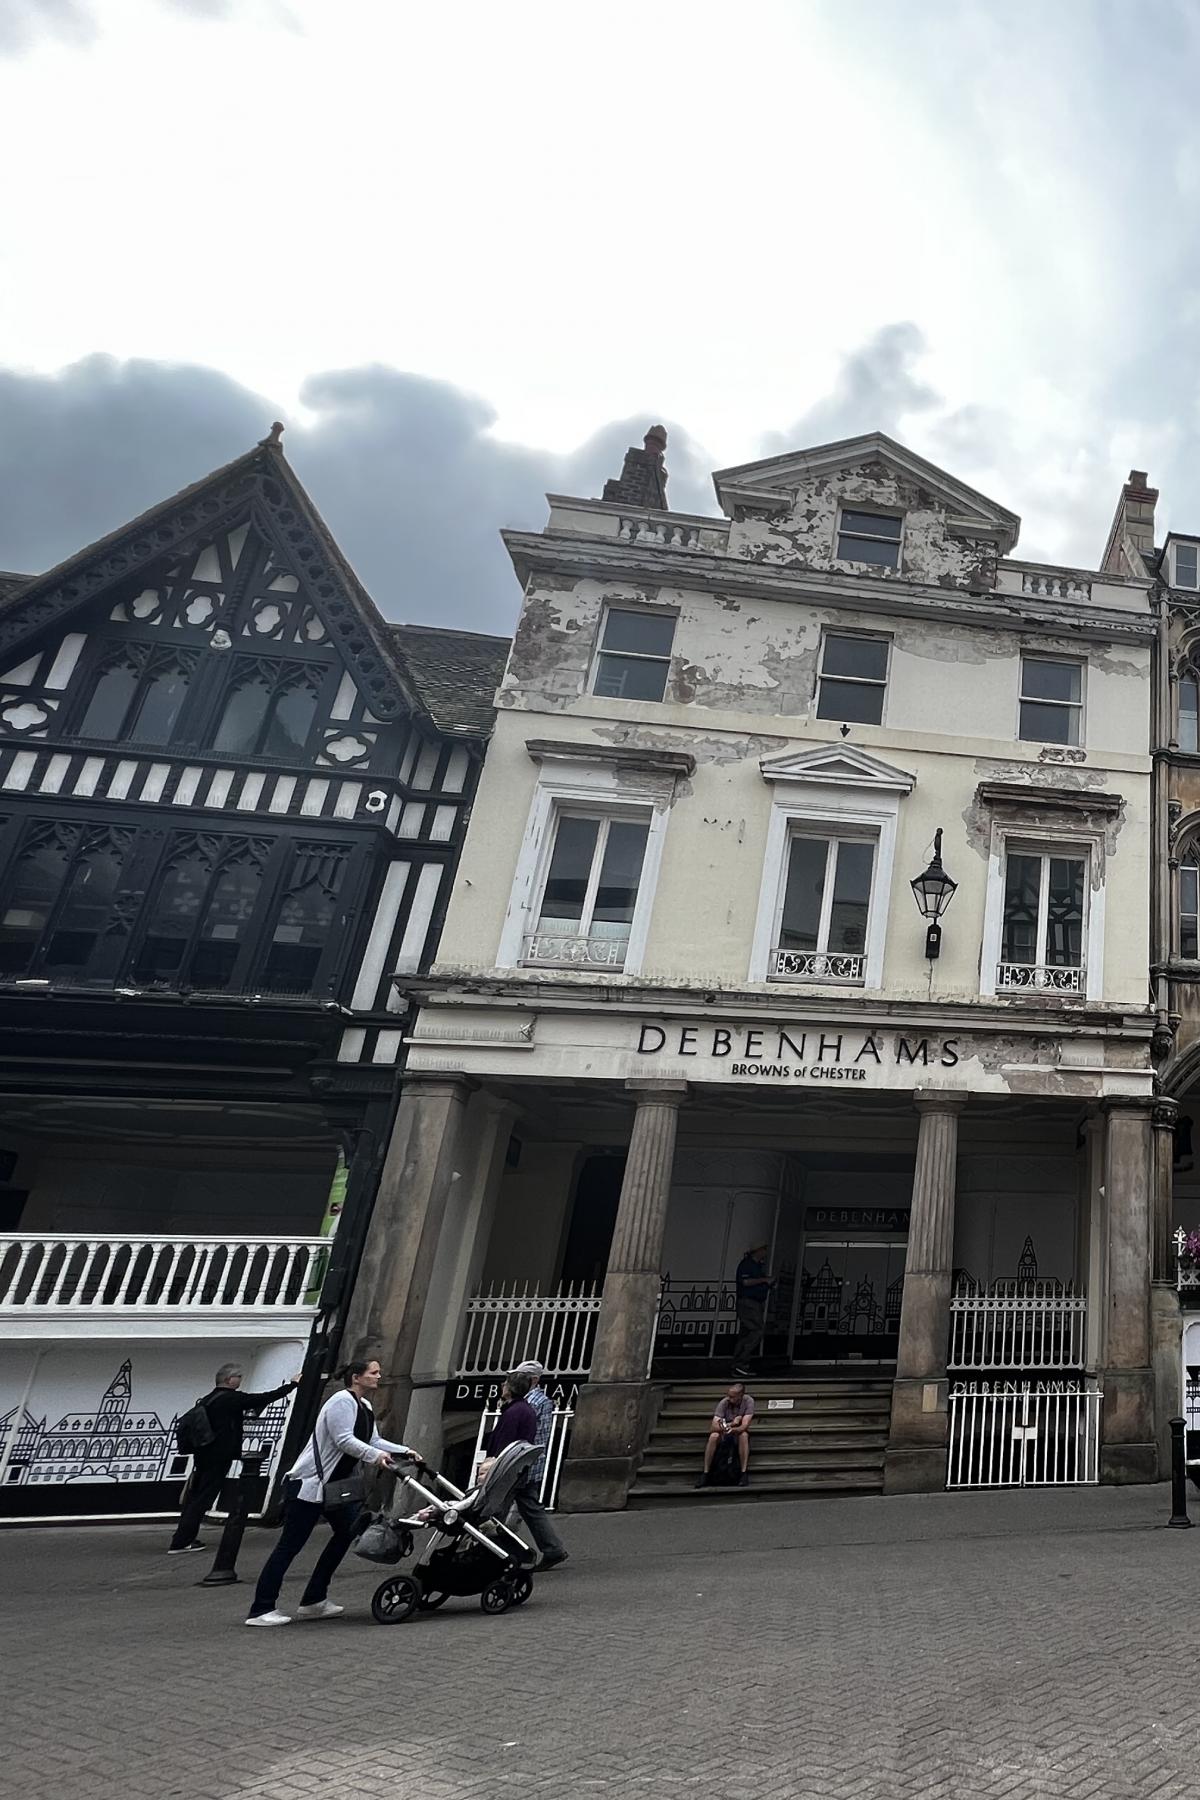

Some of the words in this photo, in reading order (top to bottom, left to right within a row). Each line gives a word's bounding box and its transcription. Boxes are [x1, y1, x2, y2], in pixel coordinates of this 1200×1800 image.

[637, 1024, 960, 1067] DEBENHAMS
[731, 1063, 790, 1078] BROWNS
[794, 1065, 807, 1078] of
[809, 1066, 867, 1081] CHESTER
[815, 1210, 910, 1224] DEBENHAM
